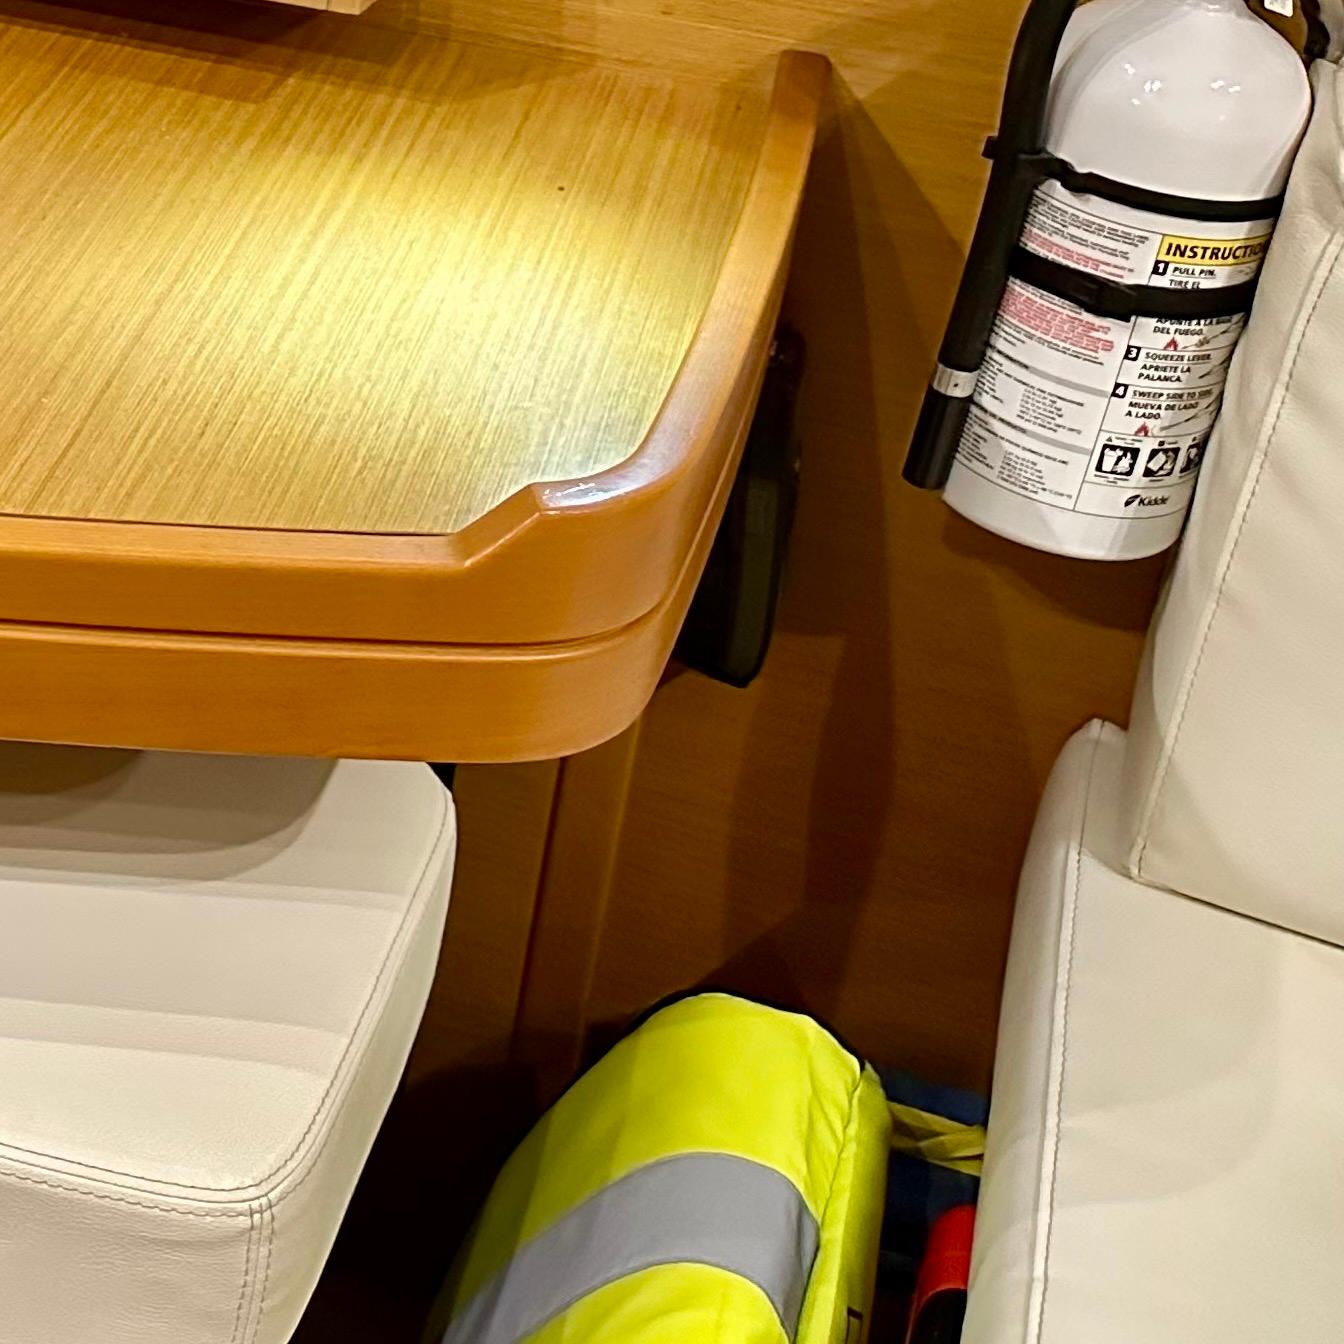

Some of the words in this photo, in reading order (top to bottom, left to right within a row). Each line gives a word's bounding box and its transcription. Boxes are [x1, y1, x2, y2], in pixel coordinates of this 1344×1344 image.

[1157, 262, 1166, 273] 1
[1172, 266, 1196, 276] PULL
[1153, 326, 1171, 335] DEL
[1129, 347, 1138, 358] 3
[1145, 352, 1184, 362] SQUEEZE
[1141, 363, 1179, 373] APRIETE
[1180, 365, 1191, 373] LA
[1116, 386, 1125, 396] 4
[1132, 389, 1164, 399] SWEEP
[1128, 401, 1162, 410] MUEVA
[1164, 403, 1177, 411] DE
[1125, 410, 1133, 418] A
